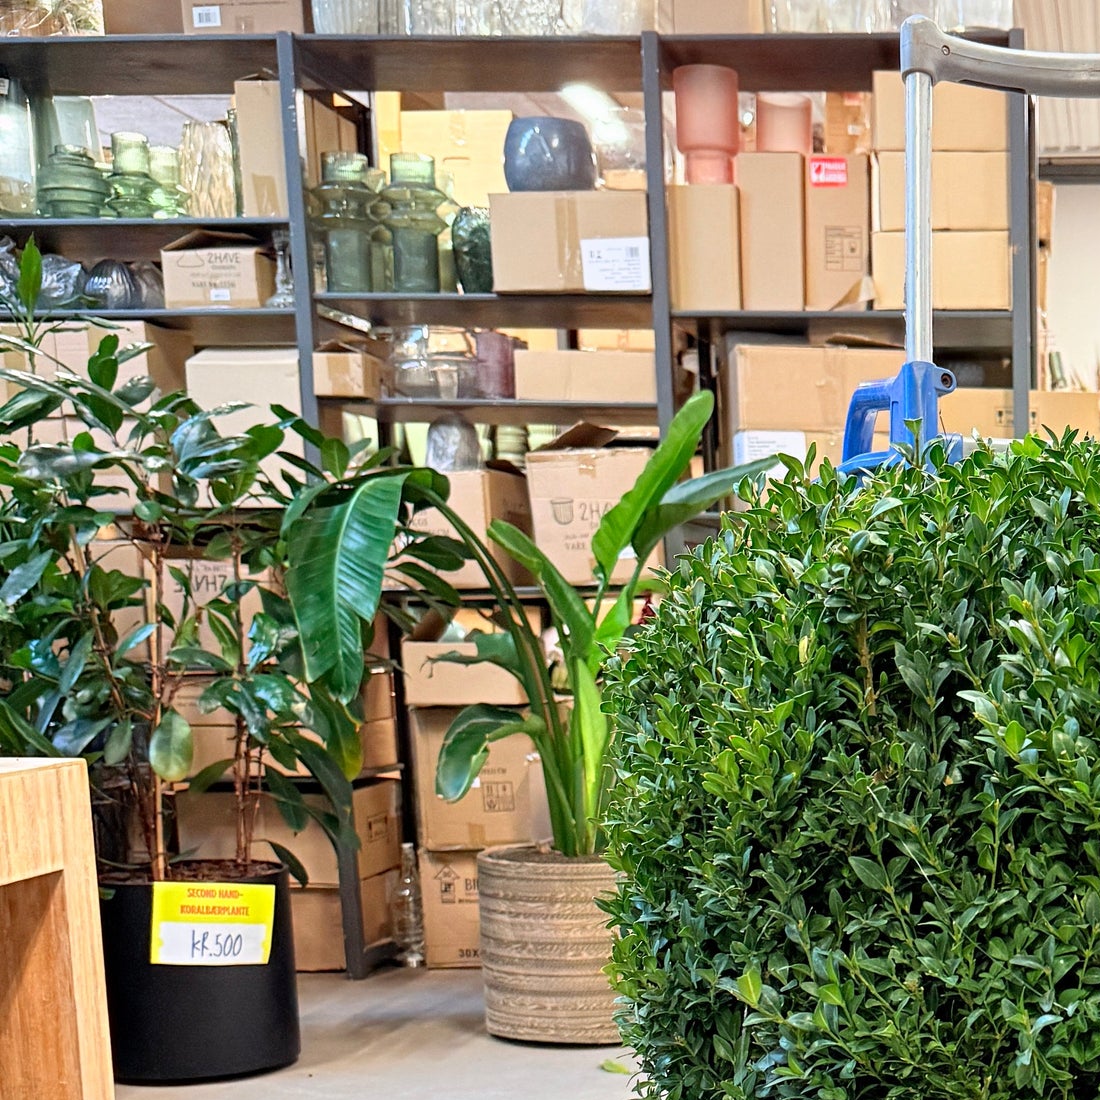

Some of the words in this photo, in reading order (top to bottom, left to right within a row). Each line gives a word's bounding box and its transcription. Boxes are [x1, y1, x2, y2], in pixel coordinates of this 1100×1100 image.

[207, 252, 240, 264] 2HAVE
[580, 502, 613, 521] 2HA
[187, 887, 217, 899] SECOND
